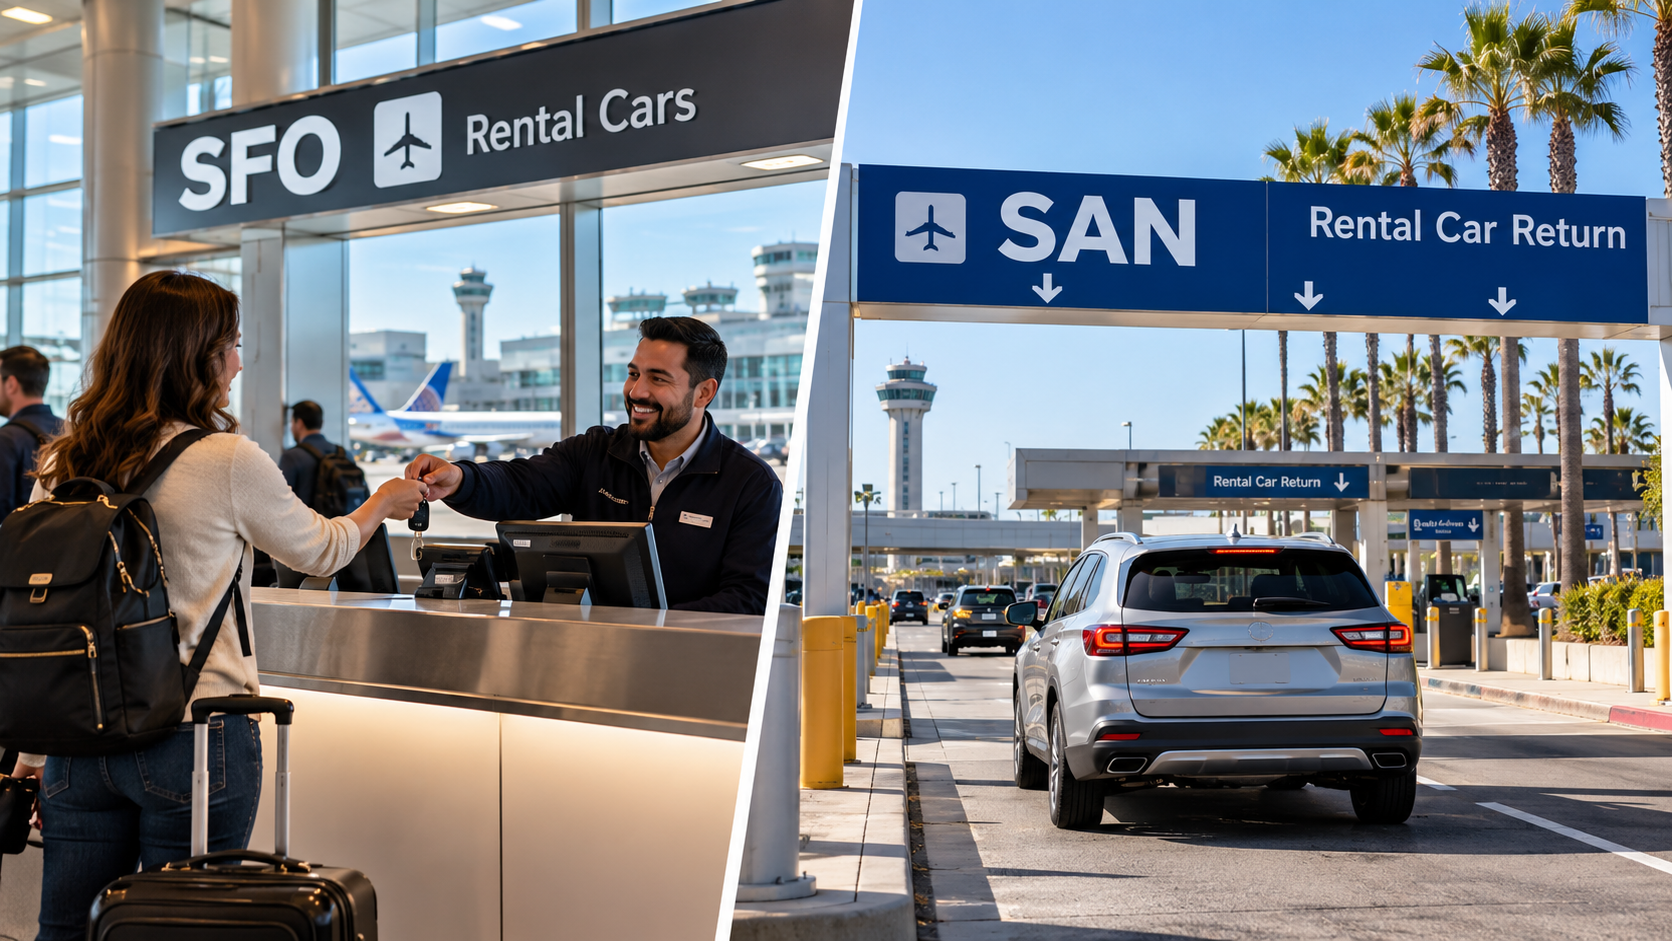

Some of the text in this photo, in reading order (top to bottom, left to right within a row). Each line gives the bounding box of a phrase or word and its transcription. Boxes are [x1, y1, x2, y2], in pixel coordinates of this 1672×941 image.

[466, 88, 697, 155] Rental Cars
[178, 115, 342, 212] SFO
[997, 191, 1196, 267] SAN
[1310, 205, 1626, 249] Rental Car Return
[1213, 475, 1321, 489] Rental Car Return
